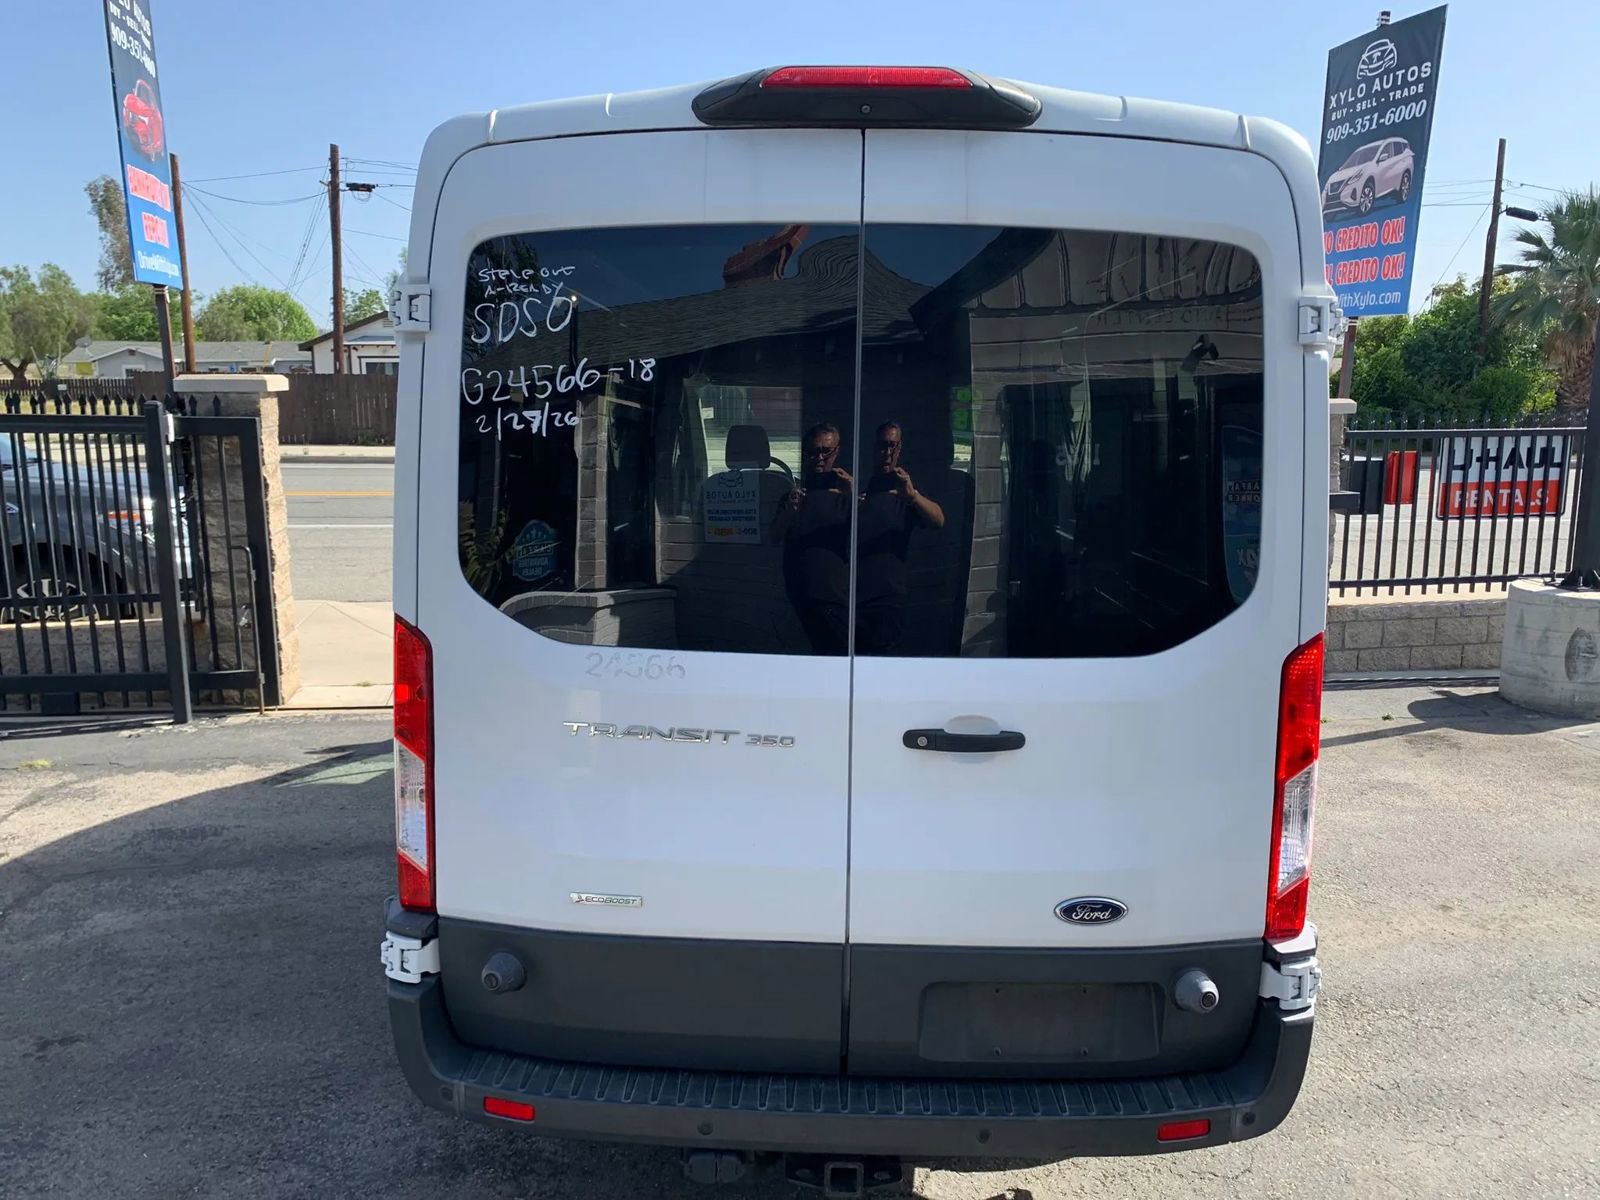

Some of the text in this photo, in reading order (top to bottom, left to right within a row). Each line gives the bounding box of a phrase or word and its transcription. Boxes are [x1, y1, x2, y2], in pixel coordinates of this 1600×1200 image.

[1329, 61, 1432, 110] XYLO AUTOS
[1331, 108, 1348, 121] BUY
[1355, 97, 1377, 113] SELL
[1388, 83, 1425, 102] TRADE
[1325, 99, 1428, 145] 909-351-6000
[1335, 222, 1379, 252] CREDITO
[1381, 216, 1406, 246] OK!
[1335, 257, 1379, 286] CREDITO
[1381, 251, 1407, 280] OK!
[563, 721, 796, 748] TRANSIT 350
[585, 895, 637, 905] ECOBOOST
[1072, 903, 1113, 920] Ford
